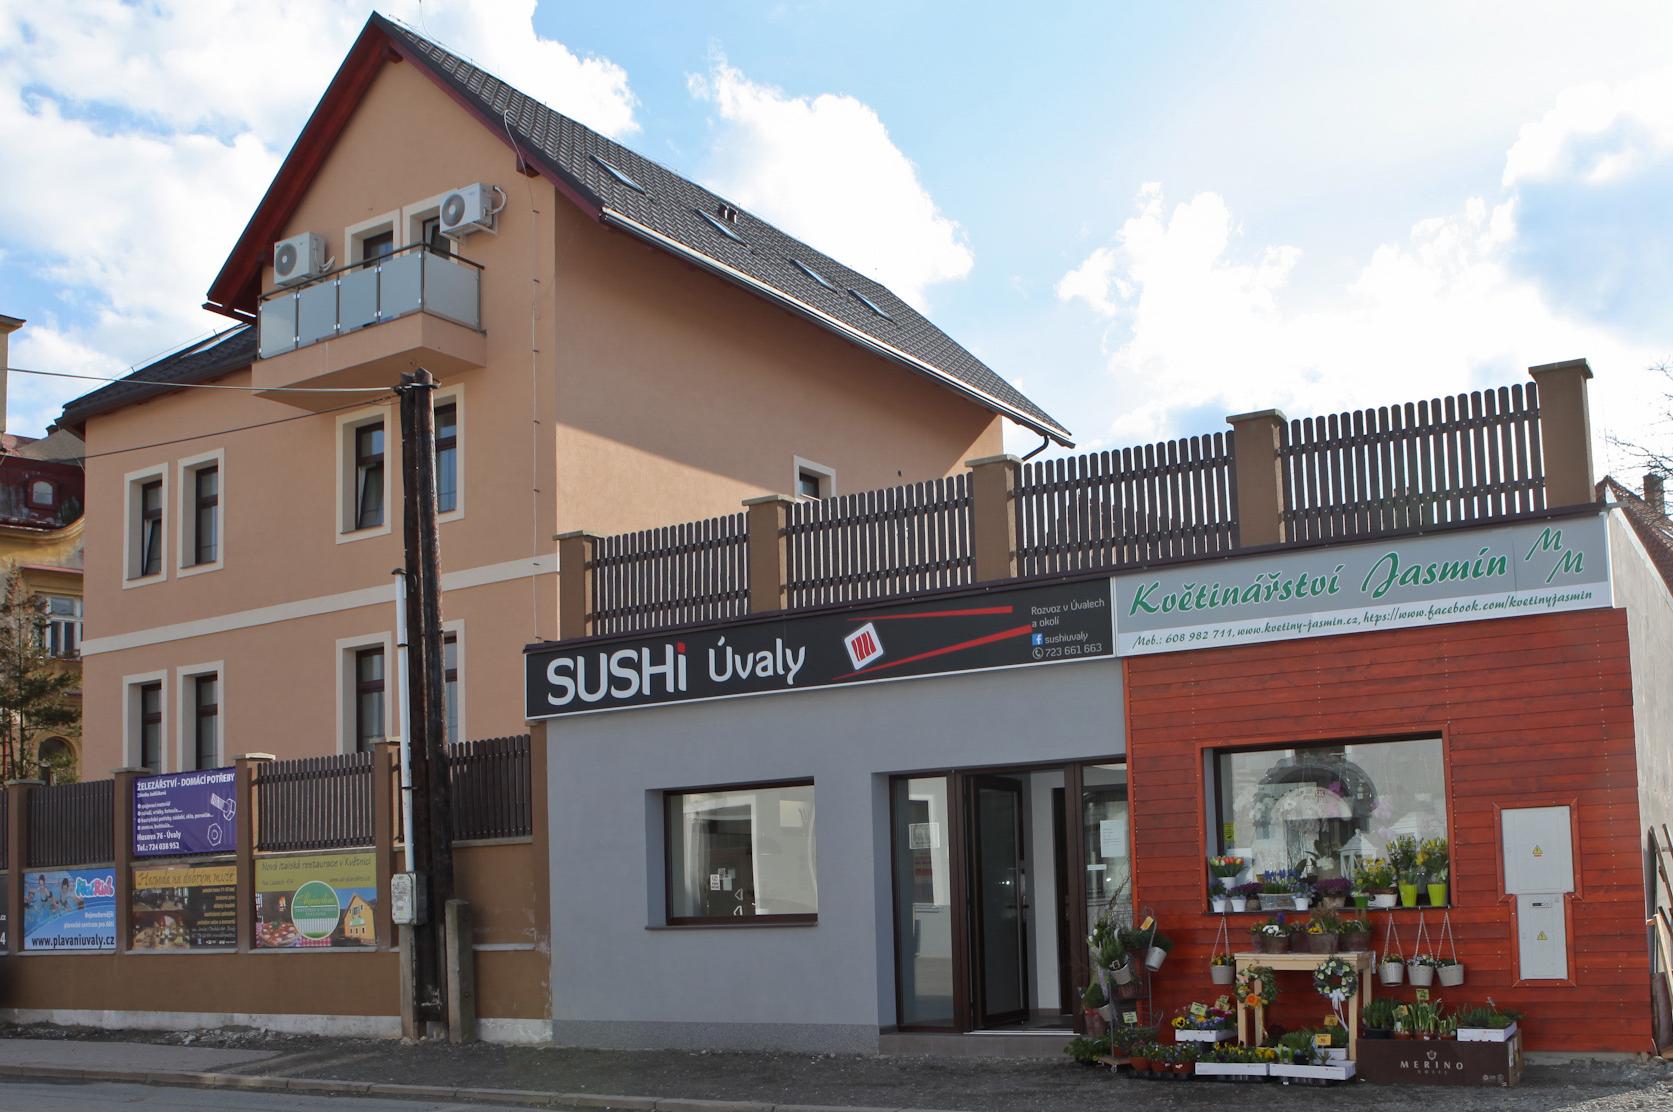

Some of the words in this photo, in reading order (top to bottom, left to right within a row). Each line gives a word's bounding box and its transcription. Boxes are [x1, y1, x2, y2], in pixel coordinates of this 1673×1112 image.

[1129, 564, 1344, 616] Květinářství
[1360, 547, 1508, 598] Jasmín
[1031, 604, 1062, 615] Rozvoz
[1063, 604, 1069, 612] v
[1070, 598, 1105, 611] Úvalech
[1032, 620, 1037, 628] a
[1039, 616, 1060, 627] okolí
[1044, 631, 1089, 645] sushiuvaly
[1132, 634, 1162, 649] Mob.:
[1165, 631, 1185, 644] 608
[1188, 631, 1209, 642] 982
[1045, 647, 1062, 657] 723
[1064, 645, 1081, 655] 661
[1083, 643, 1102, 653] 663
[708, 635, 806, 686] Úvaly
[137, 777, 177, 791] ŽELEZÁŘSTVÍ
[181, 772, 206, 787] DOMÁCÍ
[207, 772, 235, 784] POTŘEBY
[137, 833, 156, 841] Husova
[157, 831, 163, 840] 76
[167, 830, 181, 840] Úvaly
[137, 843, 148, 851] Tel.:
[169, 841, 179, 849] 952
[32, 934, 115, 949] www.plavaniuvaly.cz
[1400, 1061, 1464, 1070] MERINO
